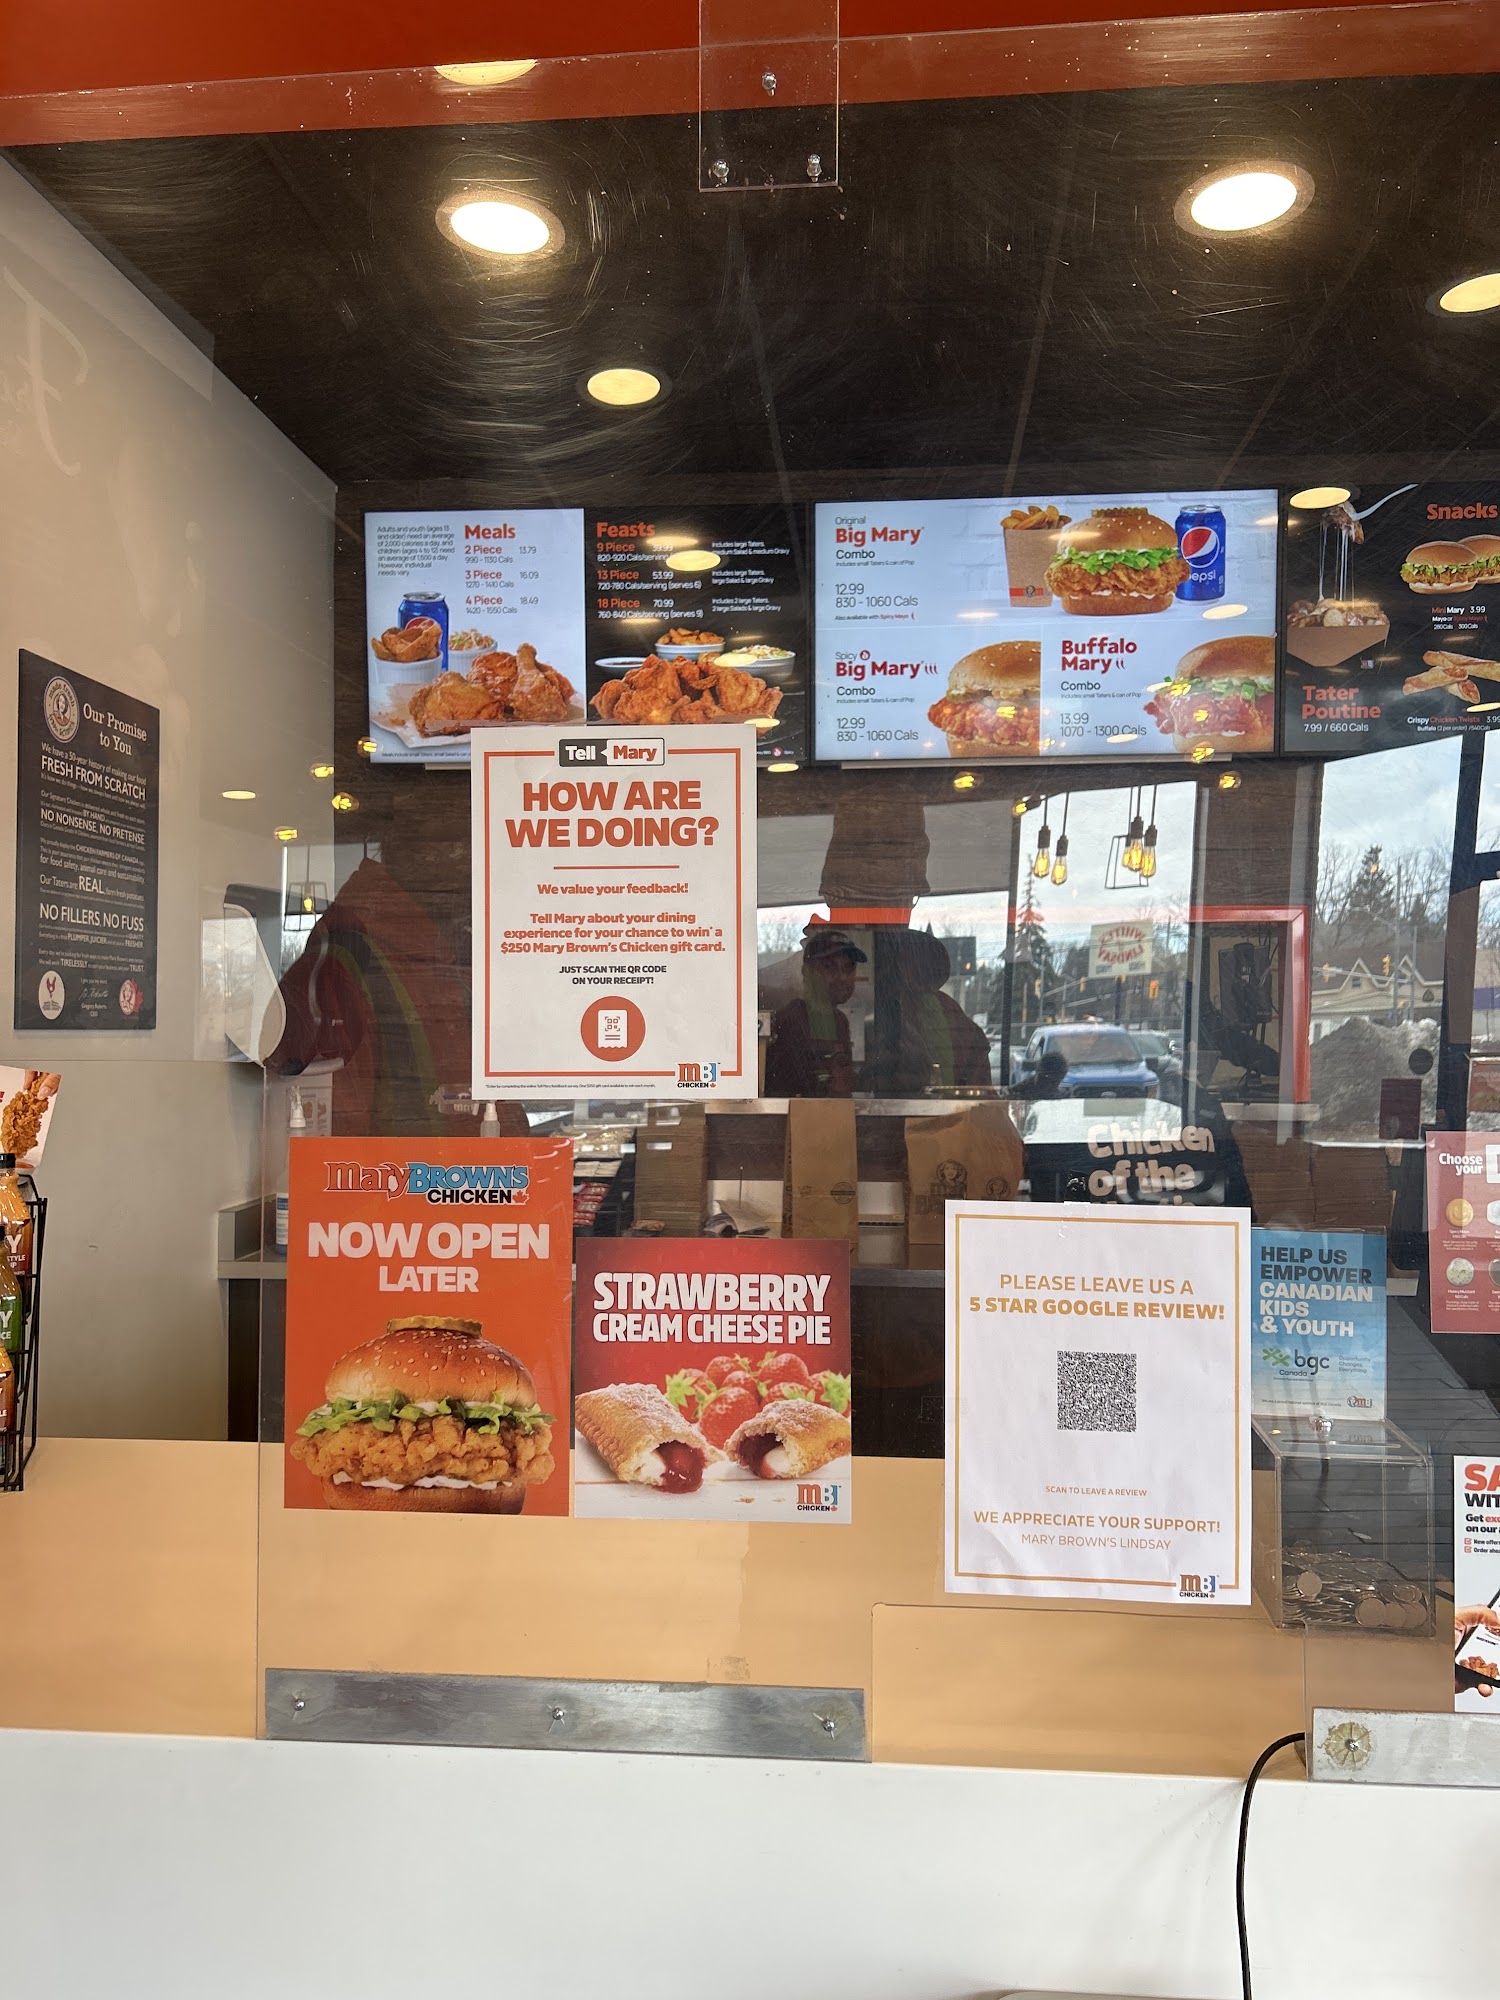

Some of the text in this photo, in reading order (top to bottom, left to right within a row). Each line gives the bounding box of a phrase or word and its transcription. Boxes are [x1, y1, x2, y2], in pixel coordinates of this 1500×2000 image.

[1427, 503, 1498, 520] Snacks
[835, 516, 866, 526] Original
[465, 524, 516, 539] Meals
[596, 522, 655, 537] Feasts
[836, 527, 921, 547] Big Mary
[465, 545, 471, 554] 2
[473, 545, 502, 554] Piece
[597, 542, 635, 552] 9 Piece
[836, 549, 875, 560] Combo
[465, 570, 471, 579] 3
[473, 570, 502, 579] Piece
[597, 570, 673, 579] 13 Piece 53.99
[1189, 569, 1216, 583] epsi
[835, 583, 864, 595] 12.99
[466, 596, 472, 605] 4
[474, 595, 502, 605] Piece
[597, 598, 608, 608] 18
[611, 598, 640, 608] Piece
[836, 597, 856, 608] 830
[866, 596, 891, 607] 1060
[894, 595, 918, 606] Cals
[1447, 607, 1465, 615] Mary
[1062, 637, 1137, 654] Buffalo
[835, 652, 857, 660] Spicy
[836, 661, 920, 681] Big Mary
[1062, 656, 1112, 674] Mary
[837, 686, 875, 695] Combo
[1061, 681, 1100, 690] Combo
[1303, 685, 1359, 701] Tater
[1060, 712, 1089, 724] 13.99
[1301, 704, 1382, 720] Poutine
[83, 703, 147, 741] Our Promise
[837, 718, 865, 729] 12.99
[1304, 723, 1322, 732] 7.99
[1330, 723, 1348, 733] 660
[1350, 722, 1369, 732] Cals
[100, 731, 132, 755] to You
[566, 745, 657, 761] Tell Mary
[41, 755, 146, 801] FRESH FROM SCRATCH
[523, 781, 701, 812] HOW ARE
[41, 808, 54, 821] NO
[100, 824, 111, 836] NO
[113, 827, 145, 844] PRETENSE
[505, 816, 719, 847] WE DOING?
[537, 883, 688, 896] We value your feedback!
[40, 902, 58, 920] NO
[103, 913, 119, 928] NO
[122, 915, 144, 932] FUSS
[530, 912, 696, 925] Tell Mary about your dining
[504, 928, 572, 940] experience
[574, 927, 592, 938] for
[595, 929, 623, 940] your
[625, 927, 668, 938] chance
[671, 928, 684, 937] to
[715, 928, 722, 937] a
[501, 941, 725, 954] $250 Mary Brown's Chicken gift card.
[559, 966, 581, 974] JUST
[627, 965, 640, 974] QR
[642, 965, 667, 973] CODE
[572, 977, 586, 985] ON
[587, 977, 612, 985] YOUR
[1087, 1120, 1215, 1158] Chicken
[1439, 1153, 1483, 1165] Choose
[1455, 1164, 1483, 1175] your
[1088, 1159, 1195, 1196] of the
[427, 1189, 512, 1204] CHICKEN
[308, 1222, 549, 1259] NOW OPEN
[1261, 1247, 1347, 1264] HELP US
[379, 1266, 479, 1292] LATER
[1260, 1264, 1372, 1284] EMPOWER
[594, 1272, 831, 1312] STRAWBERRY
[1000, 1274, 1193, 1295] PLEASE LEAVE US A
[1260, 1282, 1373, 1302] CANADIAN
[969, 1297, 1224, 1320] 5 STAR GOOGLE REVIEW!
[1260, 1300, 1309, 1317] KIDS
[593, 1313, 831, 1345] CREAM CHEESE PIE
[1260, 1316, 1354, 1337] & YOUTH
[1295, 1349, 1330, 1375] bgc
[1045, 1486, 1066, 1494] SCAN
[1069, 1487, 1079, 1495] TO
[1081, 1487, 1106, 1495] LEAVE
[1116, 1488, 1147, 1496] REVIEW
[974, 1511, 1221, 1533] WE APPRECIATE YOUR SUPPORT!
[1466, 1514, 1485, 1522] Get
[1021, 1534, 1171, 1550] MARY BROWN'S LINDSAY
